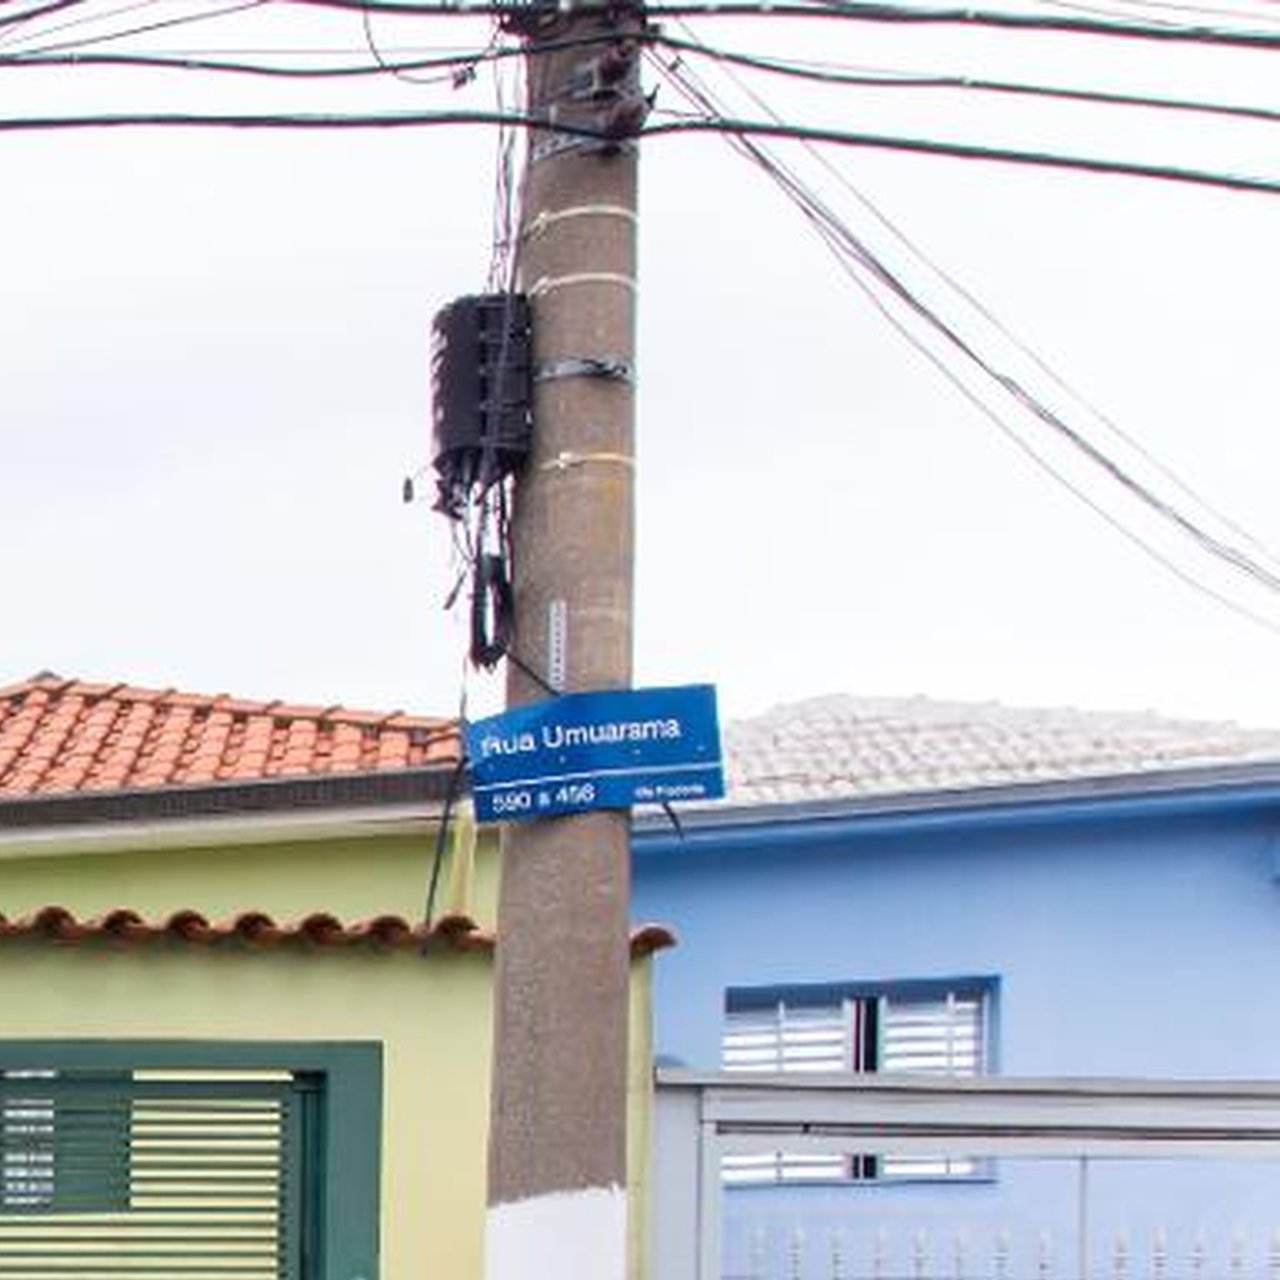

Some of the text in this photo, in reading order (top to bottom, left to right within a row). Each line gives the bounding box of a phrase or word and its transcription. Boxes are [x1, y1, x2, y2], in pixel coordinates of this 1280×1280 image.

[482, 718, 682, 758] Rua Umuarama
[492, 792, 532, 813] 590
